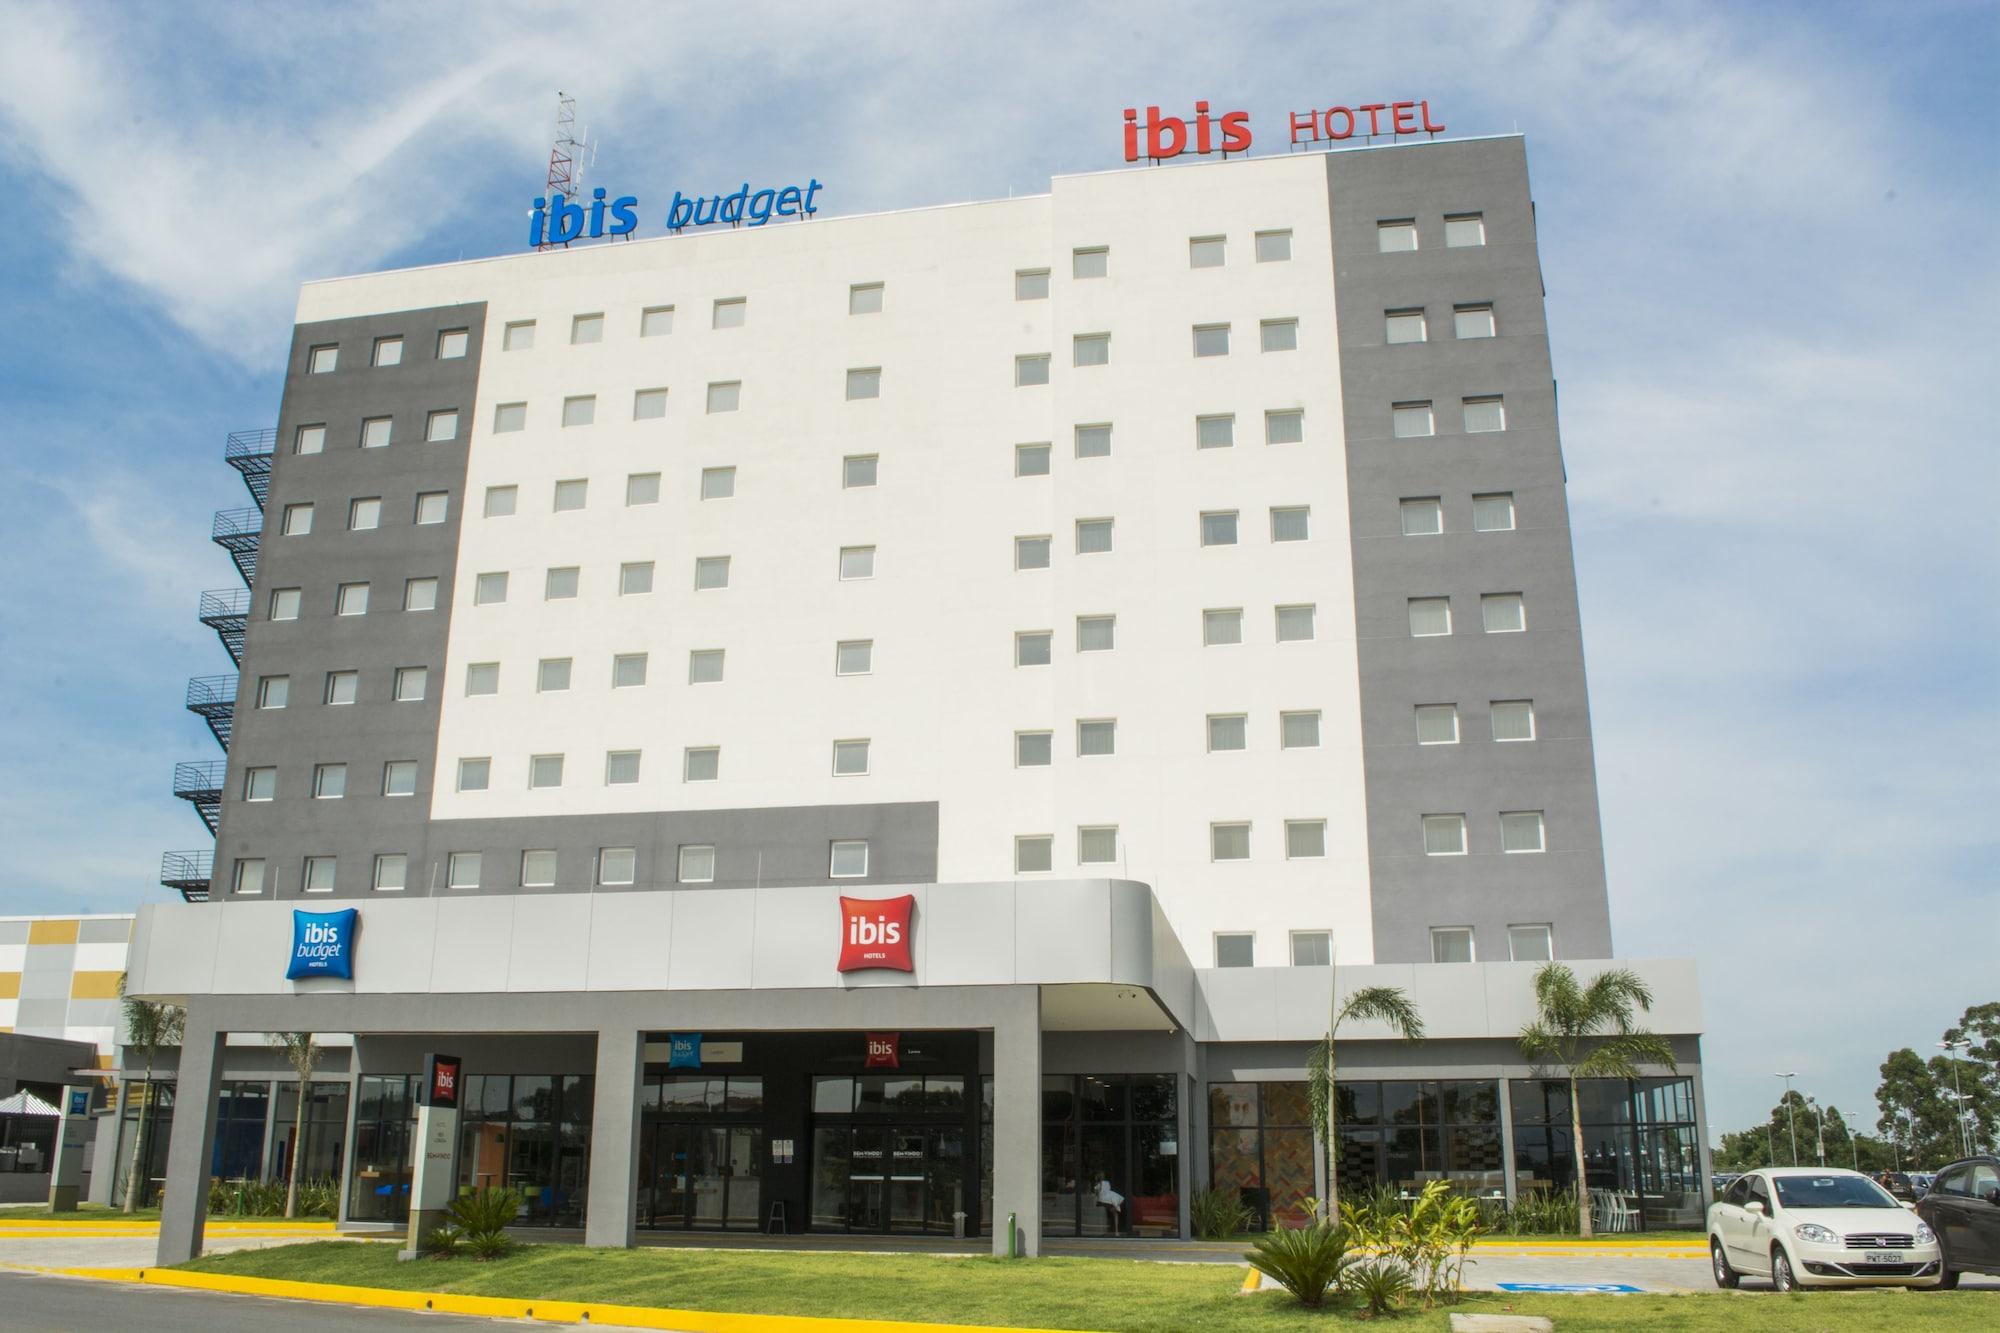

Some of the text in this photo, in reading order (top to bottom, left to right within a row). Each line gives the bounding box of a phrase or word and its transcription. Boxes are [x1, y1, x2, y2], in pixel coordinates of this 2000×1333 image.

[1124, 101, 1445, 162] ibis HOTEL
[530, 179, 823, 247] ibis budget
[304, 922, 338, 944] ibis
[850, 915, 901, 945] ibis
[297, 942, 342, 960] budget
[674, 1040, 692, 1051] ibis
[869, 1041, 893, 1055] ibis
[437, 1071, 454, 1088] ibis
